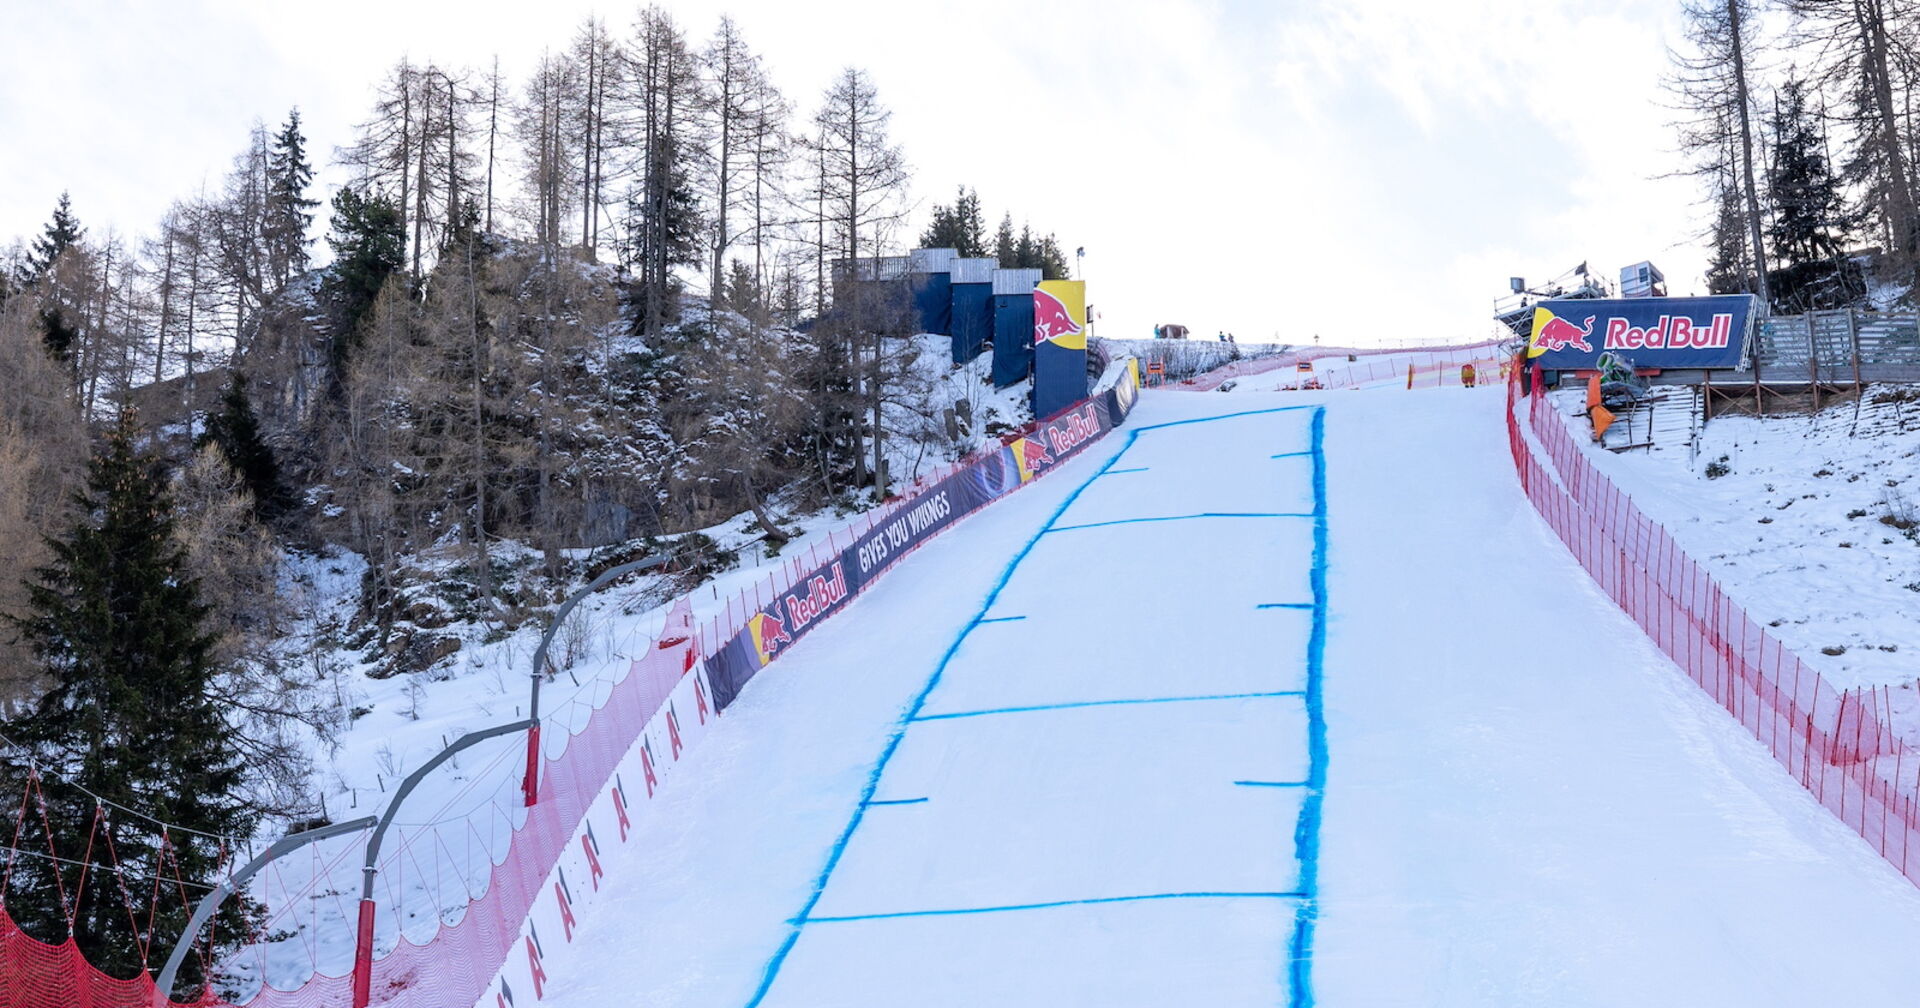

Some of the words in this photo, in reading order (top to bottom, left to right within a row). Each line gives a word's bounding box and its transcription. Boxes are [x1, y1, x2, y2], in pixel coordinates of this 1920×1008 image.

[1604, 315, 1669, 349] Red
[1667, 313, 1733, 349] Bull
[1048, 415, 1081, 456] Red
[1071, 403, 1101, 443] Bull
[859, 532, 888, 573] GIVES
[885, 517, 909, 551] YOU
[785, 578, 821, 632] Red
[814, 560, 848, 612] Bull
